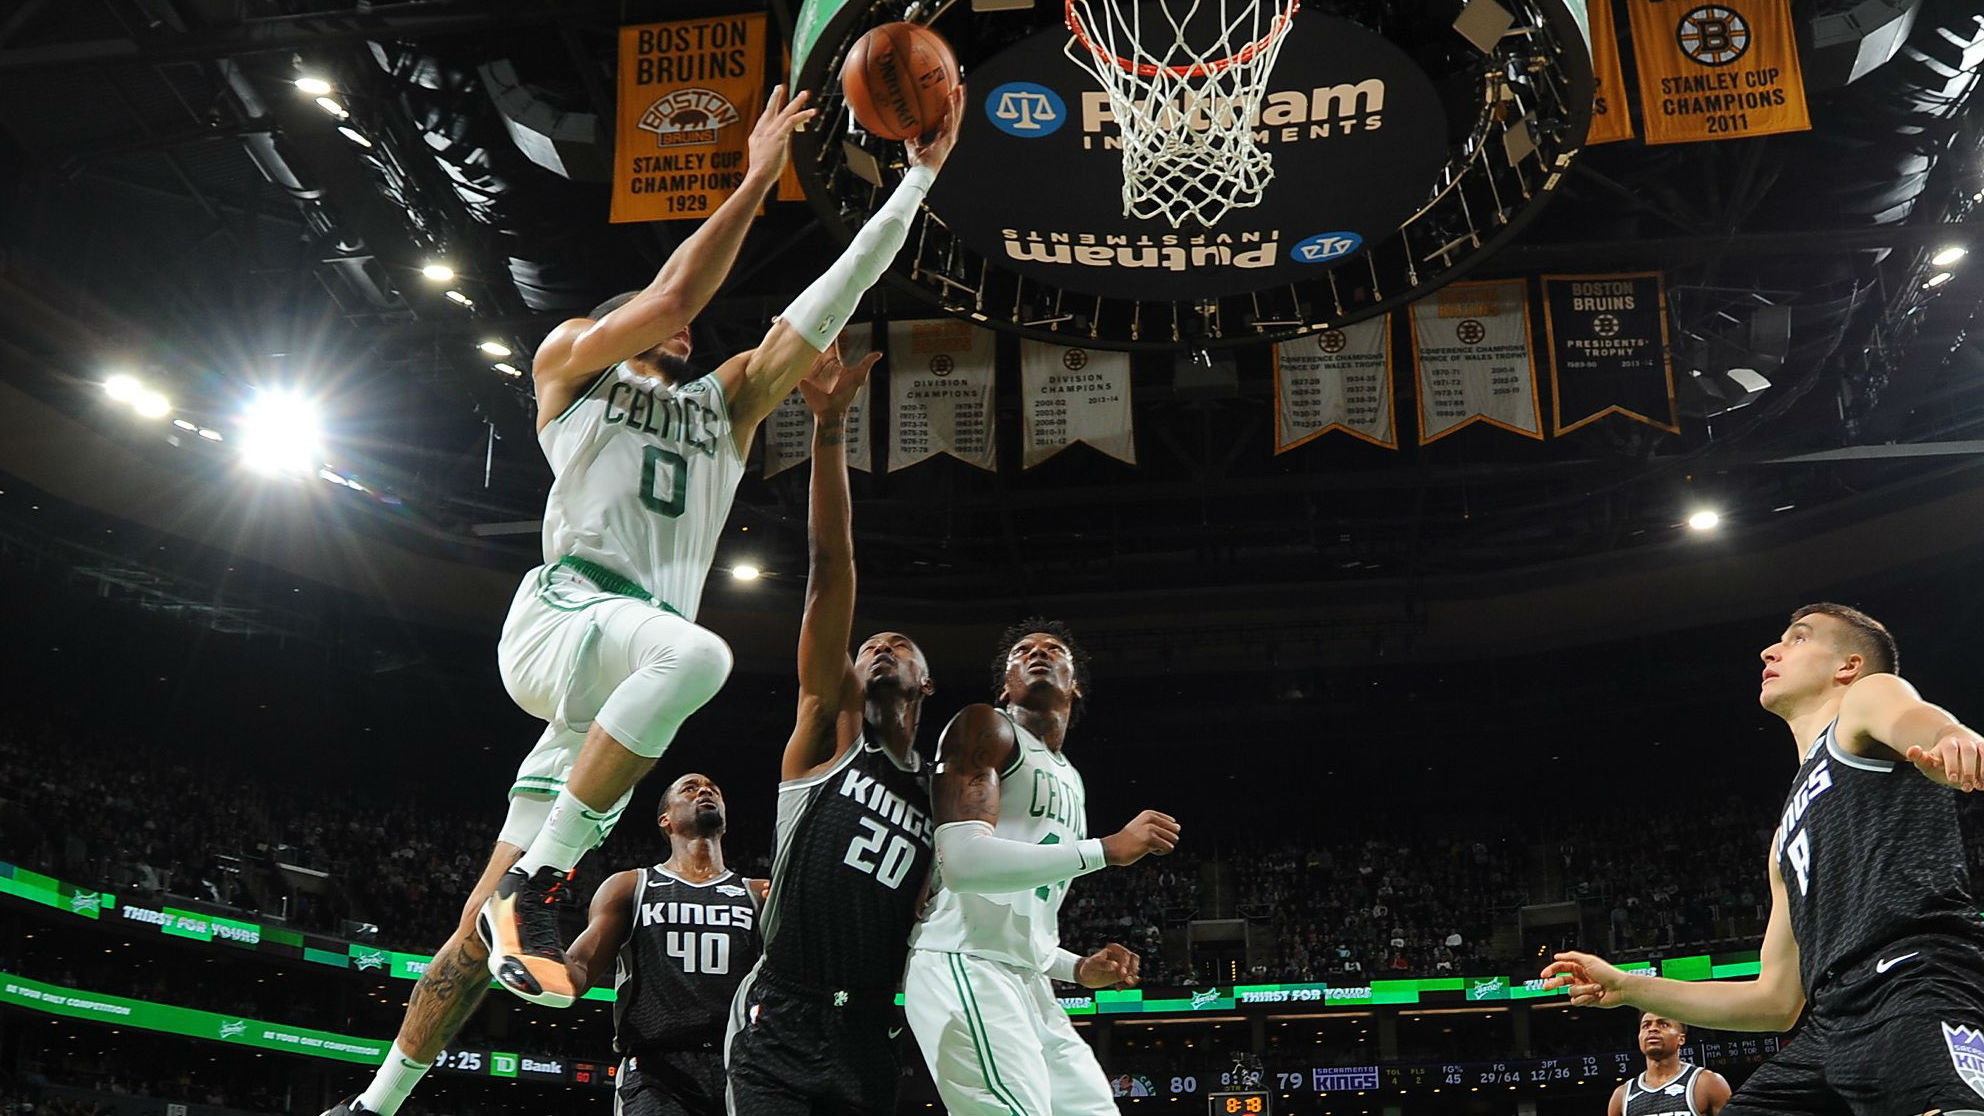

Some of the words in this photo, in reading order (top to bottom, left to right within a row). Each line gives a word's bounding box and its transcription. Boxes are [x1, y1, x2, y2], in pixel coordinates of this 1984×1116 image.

[639, 21, 747, 55] BOSTON
[637, 50, 745, 85] BRUINS
[1661, 71, 1739, 94] STANLEY
[1745, 68, 1780, 87] CUP
[878, 52, 917, 128] SPALDING
[1662, 88, 1786, 116] CHAMPIONS
[642, 92, 738, 130] BOSTON
[1707, 113, 1749, 134] 2011
[662, 131, 714, 145] BRUINS
[634, 154, 706, 173] STANLEY
[711, 152, 744, 169] CUP
[631, 173, 745, 194] CHAMPIONS
[667, 195, 708, 212] 1929
[1004, 238, 1278, 272] Putnam
[1571, 282, 1634, 296] BOSTON
[1573, 296, 1636, 311] BRUINS
[1420, 346, 1473, 355] CONFERENCE
[1475, 345, 1526, 354] CHAMPIONS
[1450, 354, 1460, 362] OF
[1465, 353, 1493, 361] WALES
[1495, 351, 1528, 360] TROPHY
[1585, 348, 1634, 358] TROPHY
[1280, 355, 1334, 364] CONFERENCE
[1335, 353, 1384, 362] CHAMPIONS
[1310, 363, 1321, 371] OF
[1324, 362, 1352, 370] WALES
[913, 379, 968, 388] DIVISION
[1049, 374, 1103, 384] DIVISION
[907, 390, 977, 399] CHAMPIONS
[1041, 382, 1112, 394] CHAMPIONS
[604, 381, 718, 459] CELTICS
[639, 444, 688, 519] 0
[839, 767, 934, 850] KINGS
[844, 815, 917, 890] 20
[641, 902, 754, 931] KINGS
[123, 905, 174, 927] THIRST
[178, 916, 207, 934] FOR
[211, 922, 261, 945] YOURS
[666, 931, 731, 975] 40
[1241, 990, 1289, 1004] THIRST
[1290, 988, 1321, 1002] FOR
[1323, 985, 1373, 1001] YOURS
[1541, 1060, 1557, 1069] 3PT
[1582, 1056, 1596, 1066] TO
[1615, 1053, 1630, 1062] STL
[492, 1057, 517, 1073] TD
[521, 1058, 563, 1075] Bank
[1316, 1066, 1375, 1076] SACRAMENTO
[1442, 1065, 1464, 1074] FG%
[1493, 1063, 1506, 1072] FG
[1530, 1066, 1571, 1082] 12/36
[1583, 1065, 1599, 1077] 12
[1618, 1062, 1627, 1073] 3
[1169, 1076, 1197, 1094] 80
[1276, 1072, 1303, 1090] 79
[1315, 1075, 1377, 1091] KINGS
[1445, 1074, 1462, 1085] 45
[1480, 1071, 1521, 1084] 29/64
